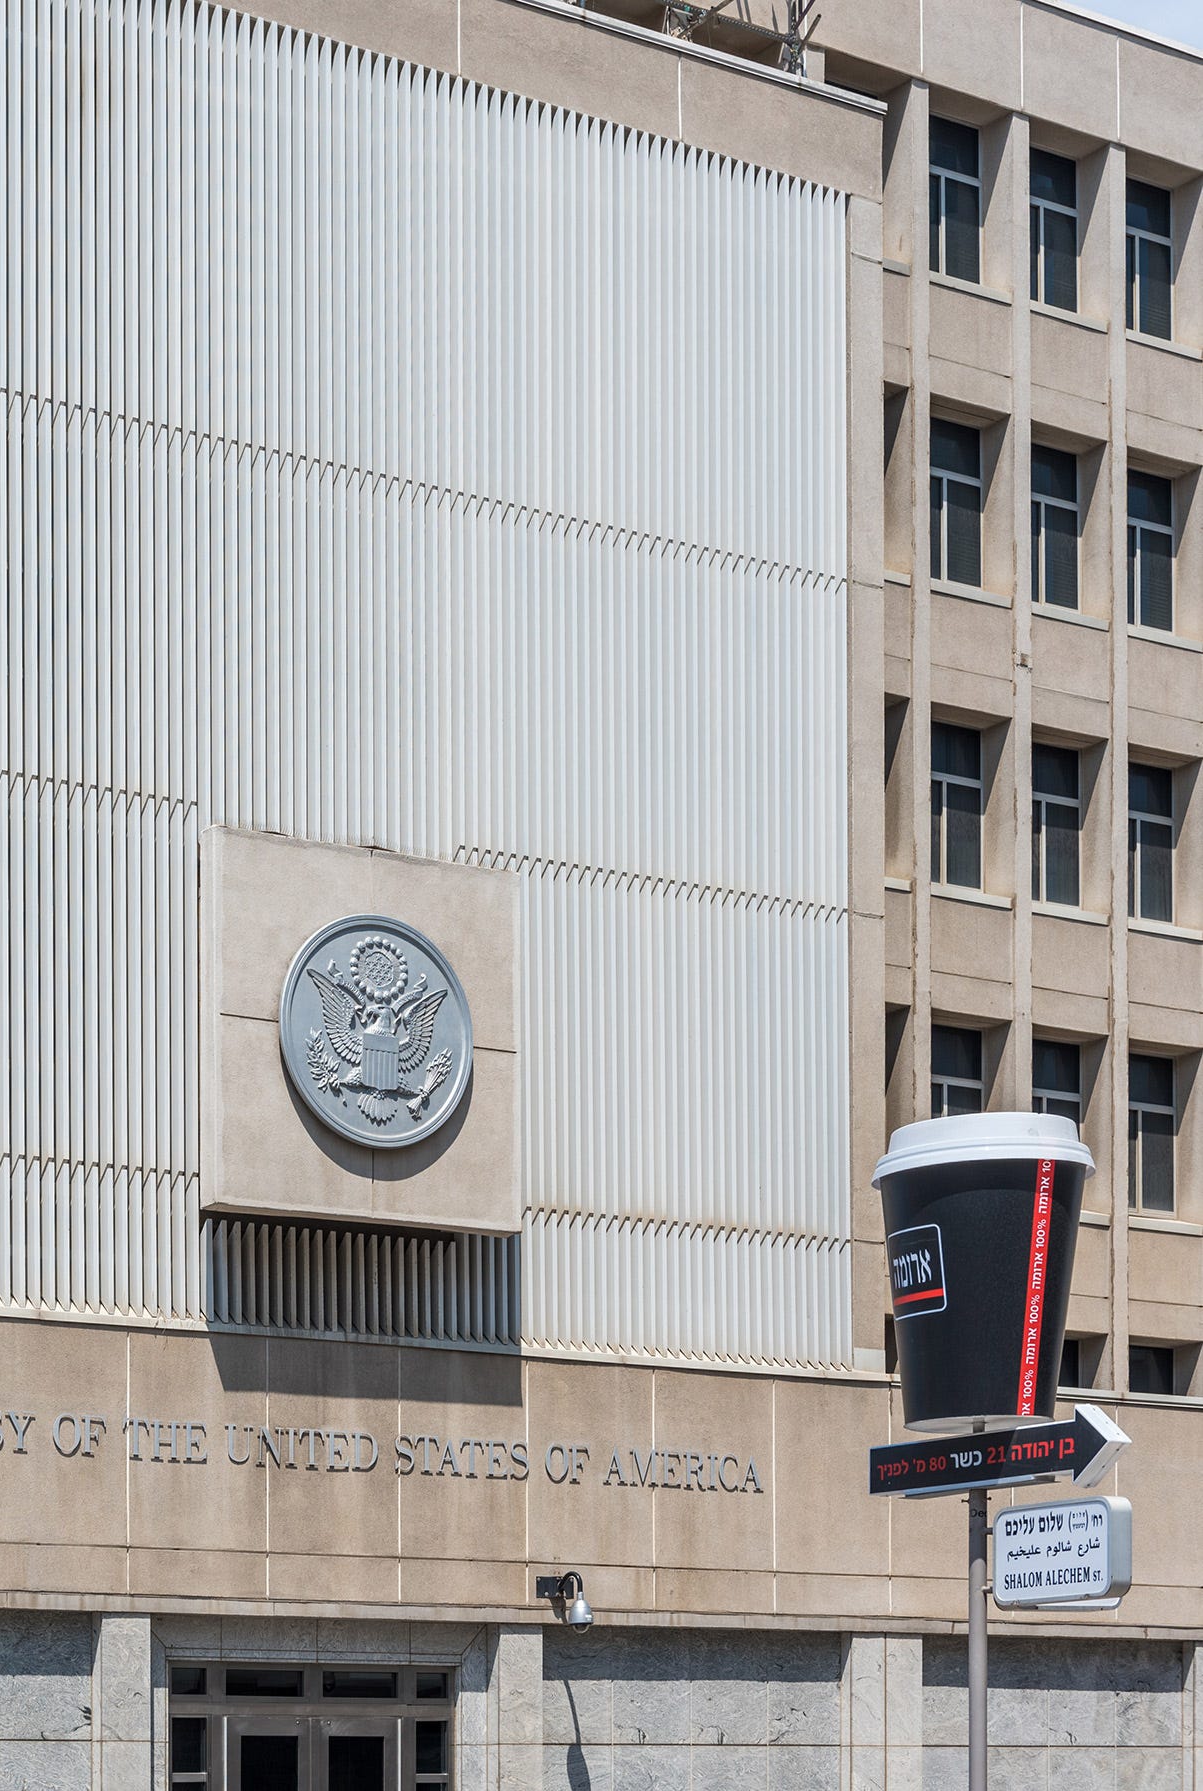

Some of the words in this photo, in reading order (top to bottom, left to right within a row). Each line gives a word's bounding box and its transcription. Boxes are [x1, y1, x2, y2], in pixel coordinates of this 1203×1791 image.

[1038, 1176, 1050, 1214] ארומה
[1035, 1219, 1046, 1248] 100%
[893, 1248, 932, 1289] ארומה
[1032, 1252, 1043, 1289] ארומה
[1029, 1294, 1040, 1323] 100%
[1026, 1327, 1037, 1365] ארומה
[1023, 1369, 1034, 1398] 100%
[52, 1413, 106, 1458] OF
[122, 1416, 208, 1465] THE
[224, 1423, 379, 1473] UNITED
[394, 1434, 530, 1480] STATES
[545, 1441, 590, 1485] OF
[602, 1446, 765, 1494] AMERICA
[950, 1449, 983, 1468] כשר
[986, 1445, 1006, 1464] 21
[1011, 1440, 1054, 1462] יהודה
[1058, 1437, 1075, 1459] בן
[877, 1460, 909, 1481] לפניך
[929, 1455, 947, 1471] 80
[1005, 1514, 1035, 1536] עליכם
[1038, 1511, 1064, 1533] שלום
[1007, 1544, 1041, 1562] عليخيم
[1046, 1540, 1072, 1558] شالوم
[1077, 1536, 1101, 1557] شارع
[1004, 1571, 1043, 1590] SHALOM
[1045, 1566, 1091, 1586] ALECHEM
[1092, 1570, 1104, 1582] ST.
